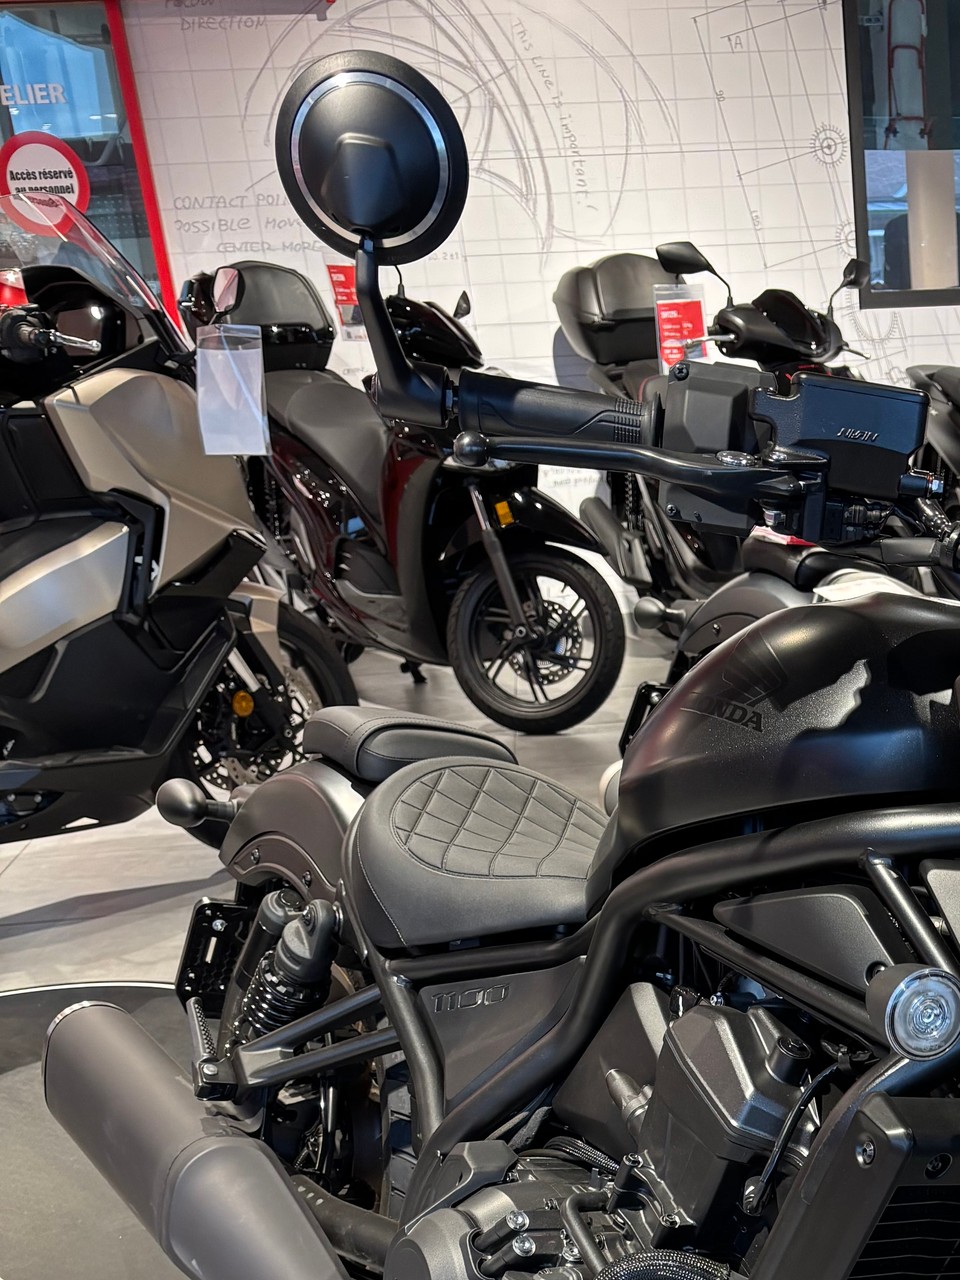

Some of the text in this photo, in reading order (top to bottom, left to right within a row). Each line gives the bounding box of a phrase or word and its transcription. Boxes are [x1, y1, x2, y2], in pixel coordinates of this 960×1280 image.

[180, 17, 267, 32] DIRECTION
[734, 35, 744, 49] A
[513, 17, 533, 51] This
[552, 91, 563, 109] is
[9, 168, 74, 181] Accès réservé
[174, 196, 247, 210] CONTACT
[216, 242, 271, 253] CENTER
[432, 983, 510, 1013] 1100
